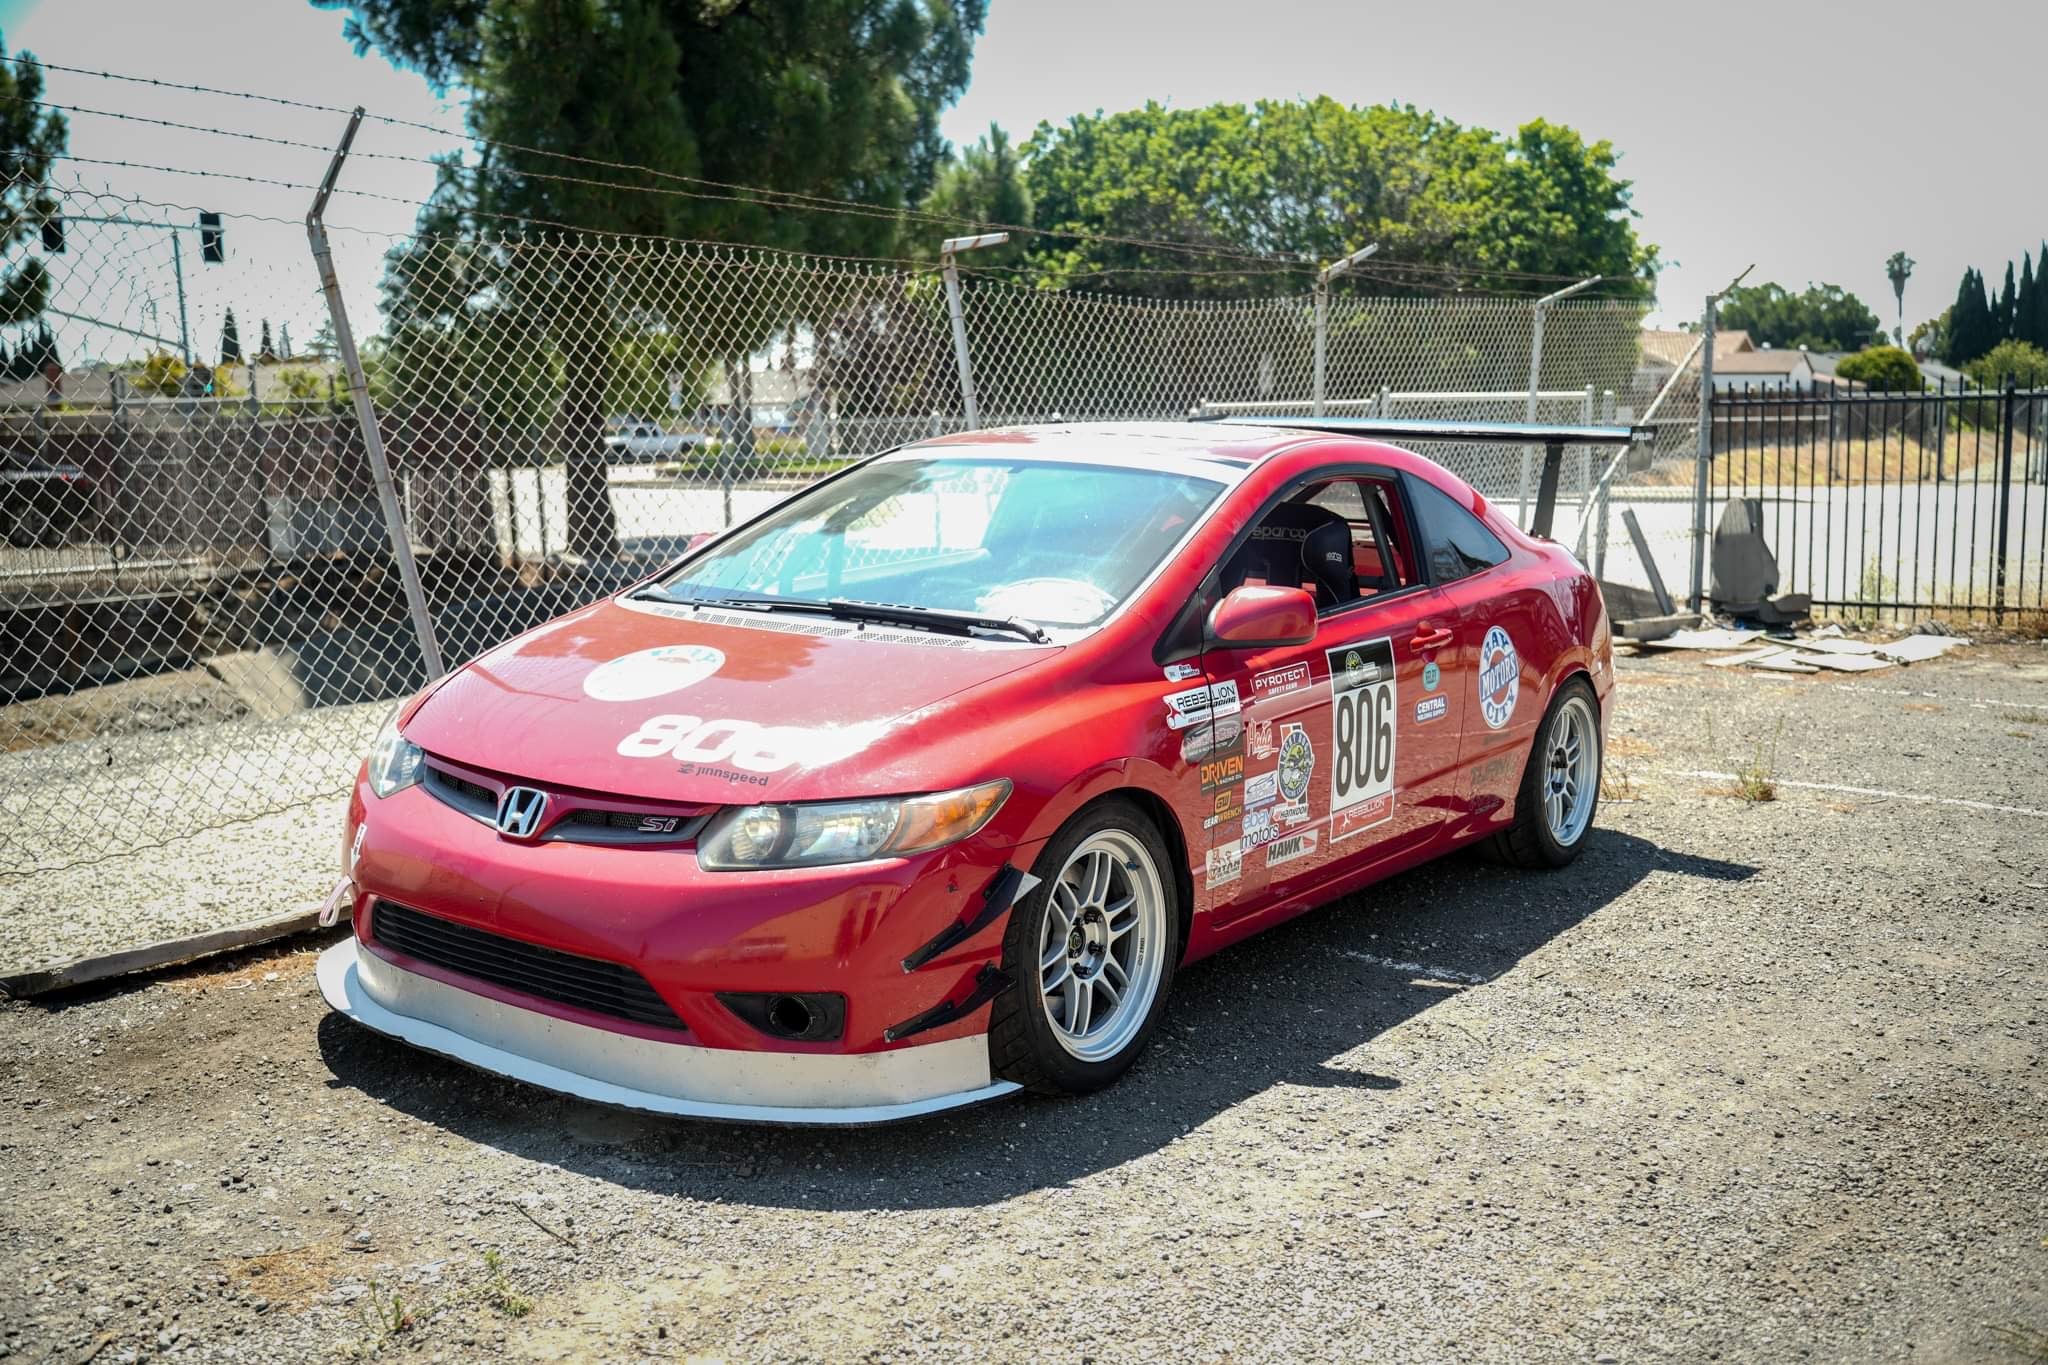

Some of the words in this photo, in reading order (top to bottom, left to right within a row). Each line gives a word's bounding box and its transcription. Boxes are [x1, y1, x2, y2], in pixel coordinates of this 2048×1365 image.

[1255, 668, 1305, 690] PYROTECT
[1481, 653, 1517, 701] MOTORS
[1417, 697, 1445, 714] CENTRAL
[1335, 684, 1392, 797] 806
[696, 766, 769, 787] jinnspeed
[1201, 755, 1243, 786] DRIVEN
[638, 816, 679, 832] Si
[1243, 808, 1272, 830] ebay
[1241, 825, 1279, 849] motors
[1268, 836, 1302, 860] HAWK
